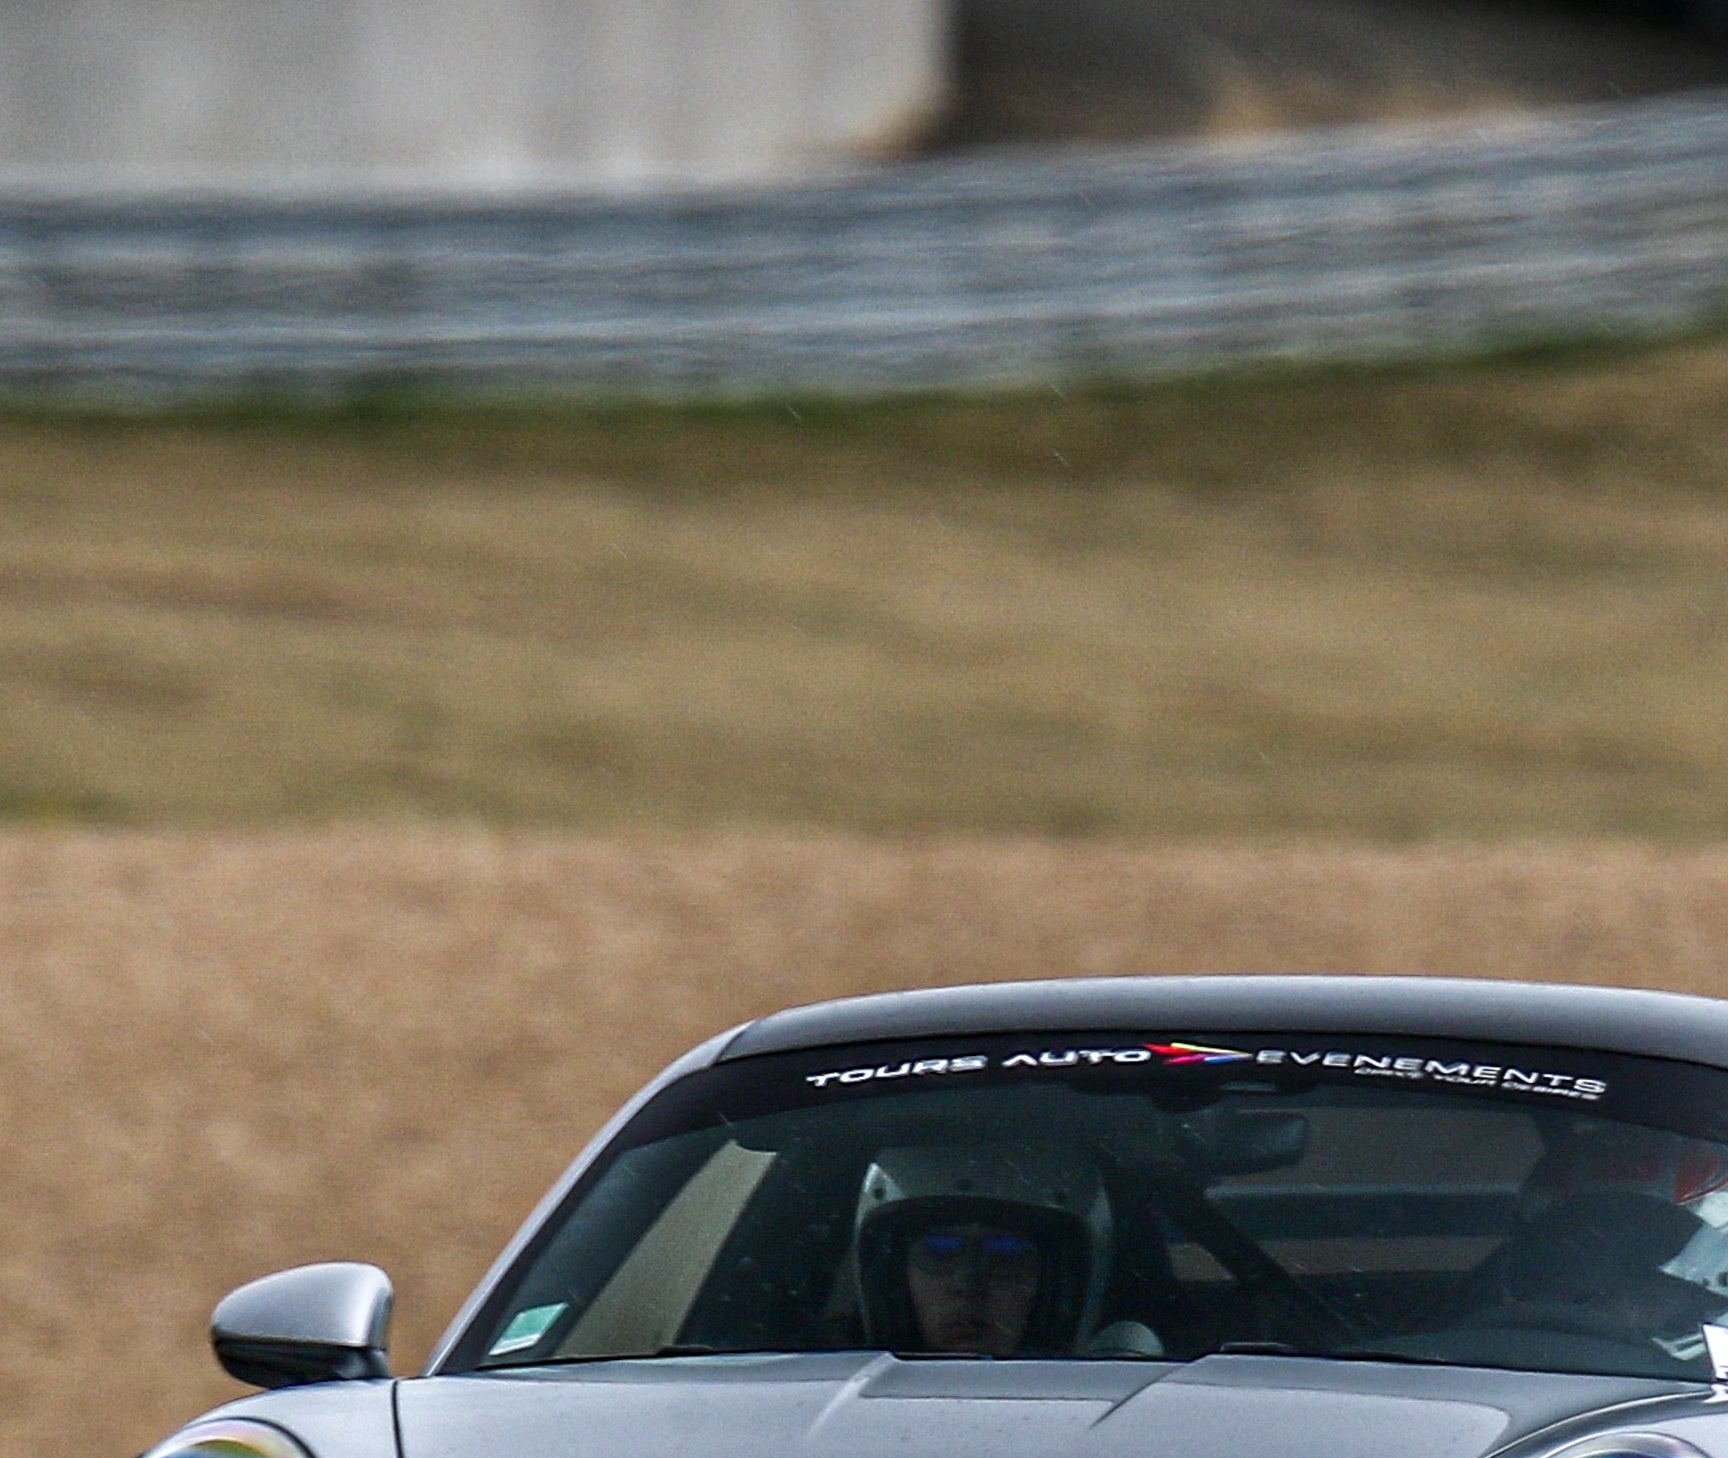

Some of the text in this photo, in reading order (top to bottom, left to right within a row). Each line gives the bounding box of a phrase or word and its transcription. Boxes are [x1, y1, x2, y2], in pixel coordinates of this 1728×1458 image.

[806, 1049, 1607, 1093] TOURS AUTO EVENEMENTS
